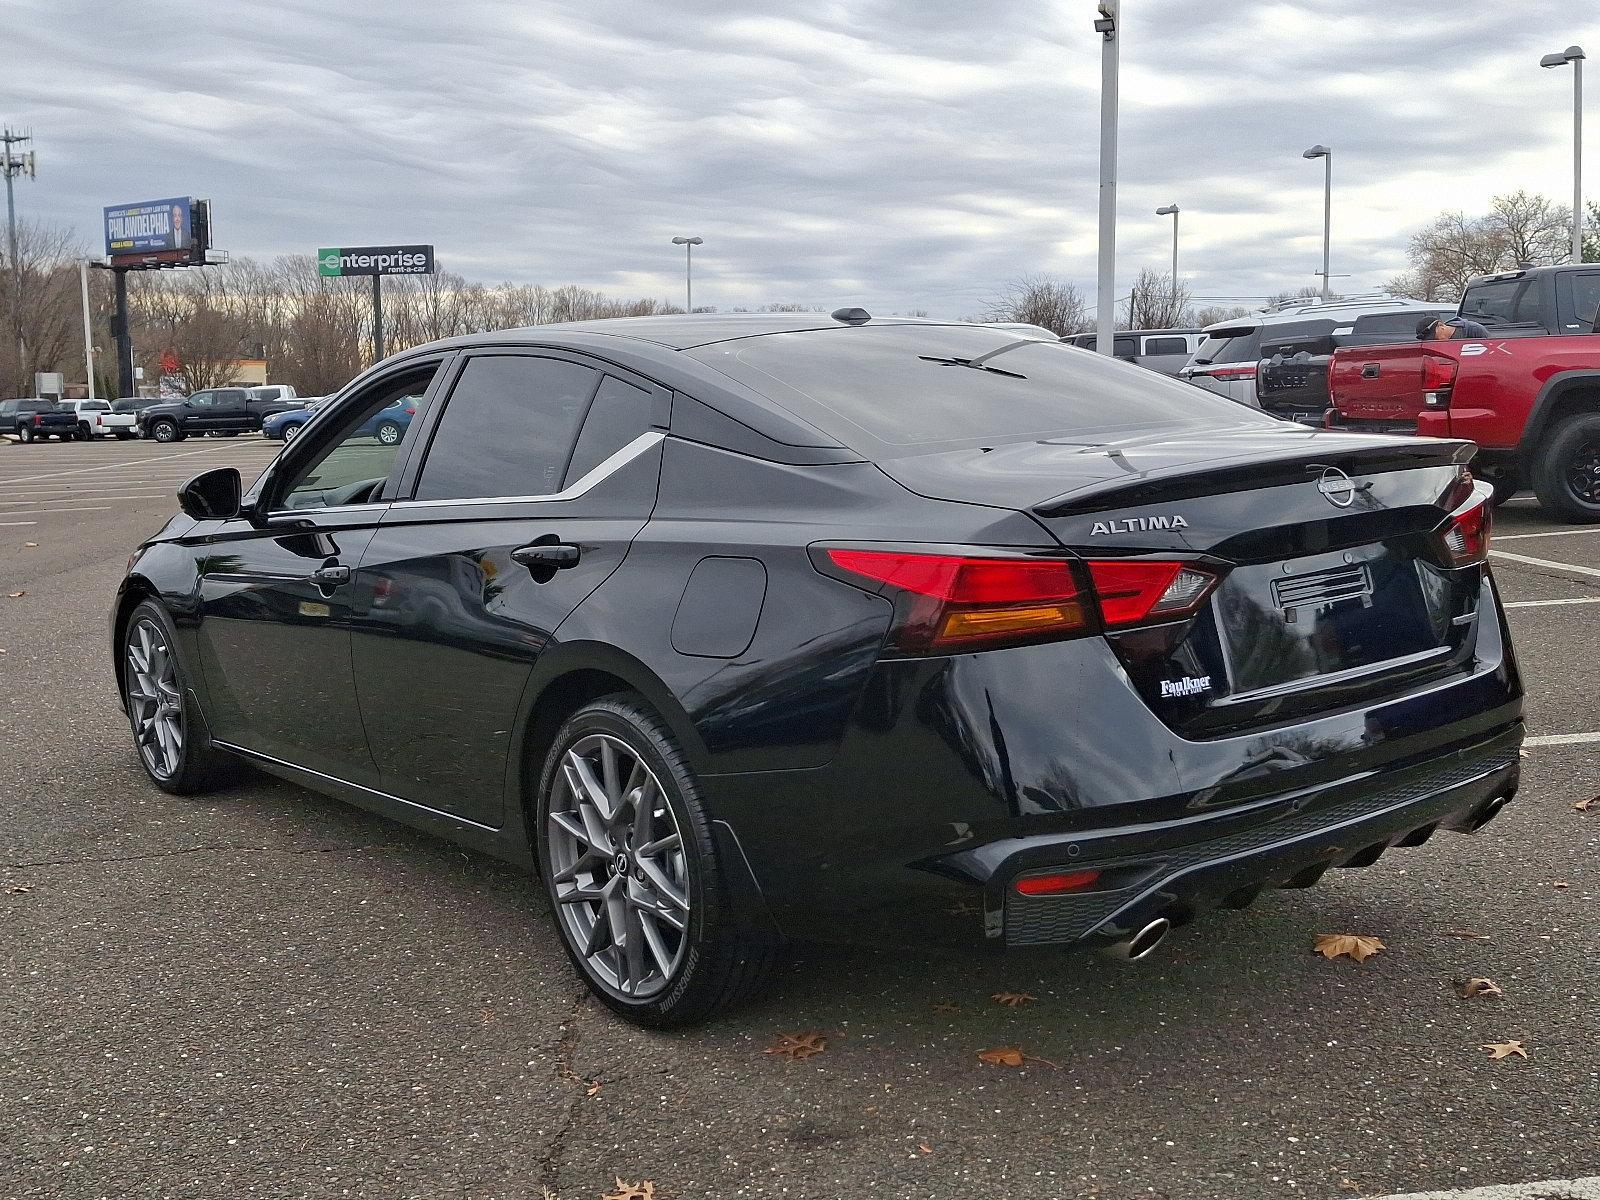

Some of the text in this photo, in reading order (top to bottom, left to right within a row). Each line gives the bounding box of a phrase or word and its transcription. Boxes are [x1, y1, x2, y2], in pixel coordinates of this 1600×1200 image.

[108, 213, 170, 240] PHILAWDELPHIA
[320, 250, 427, 271] enterprise
[1090, 515, 1189, 537] ALTIMA
[1160, 676, 1211, 695] Faulkner
[659, 946, 699, 1015] BRIDGESTONE
